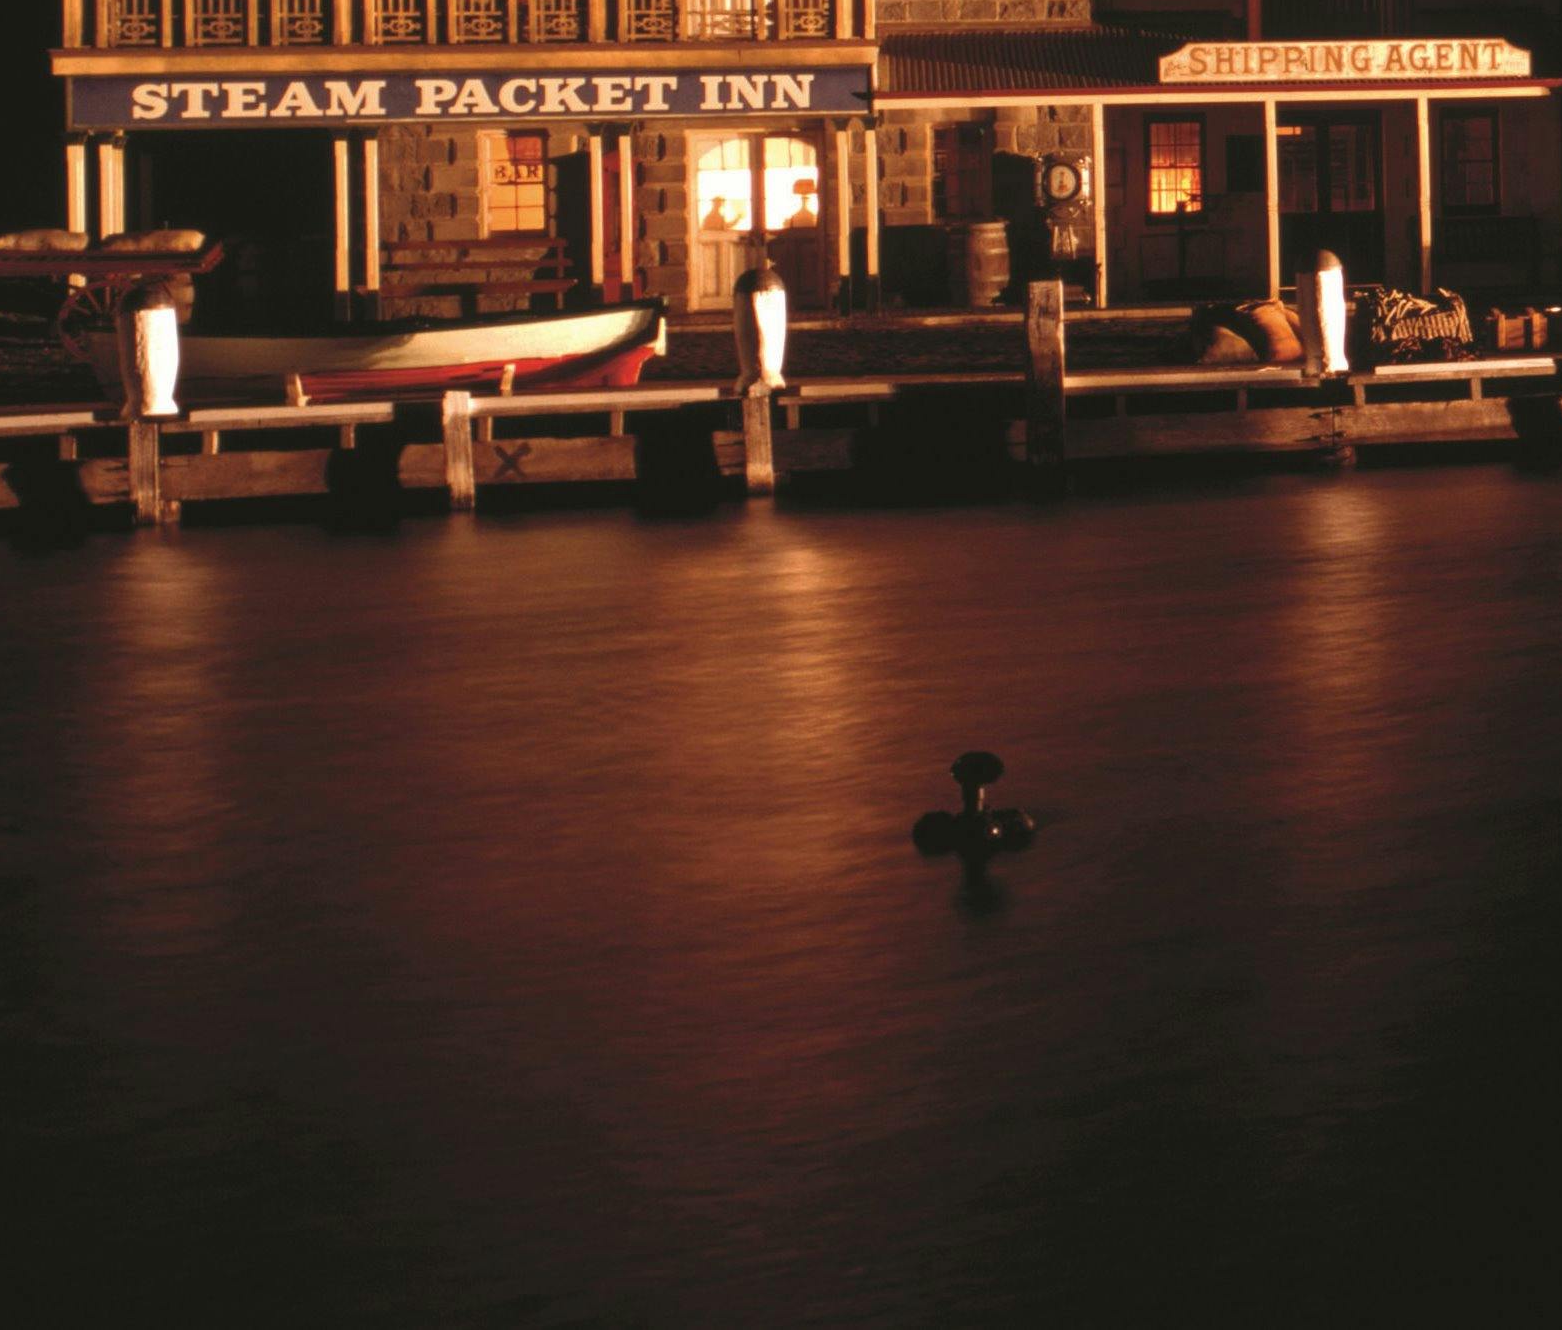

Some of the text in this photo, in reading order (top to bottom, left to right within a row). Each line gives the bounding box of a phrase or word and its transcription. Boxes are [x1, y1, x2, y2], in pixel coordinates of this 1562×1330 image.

[1188, 43, 1373, 75] SHIPPING
[1387, 42, 1505, 72] AGENT
[132, 74, 815, 120] STEAM PACKET INN
[493, 165, 540, 179] BAR
